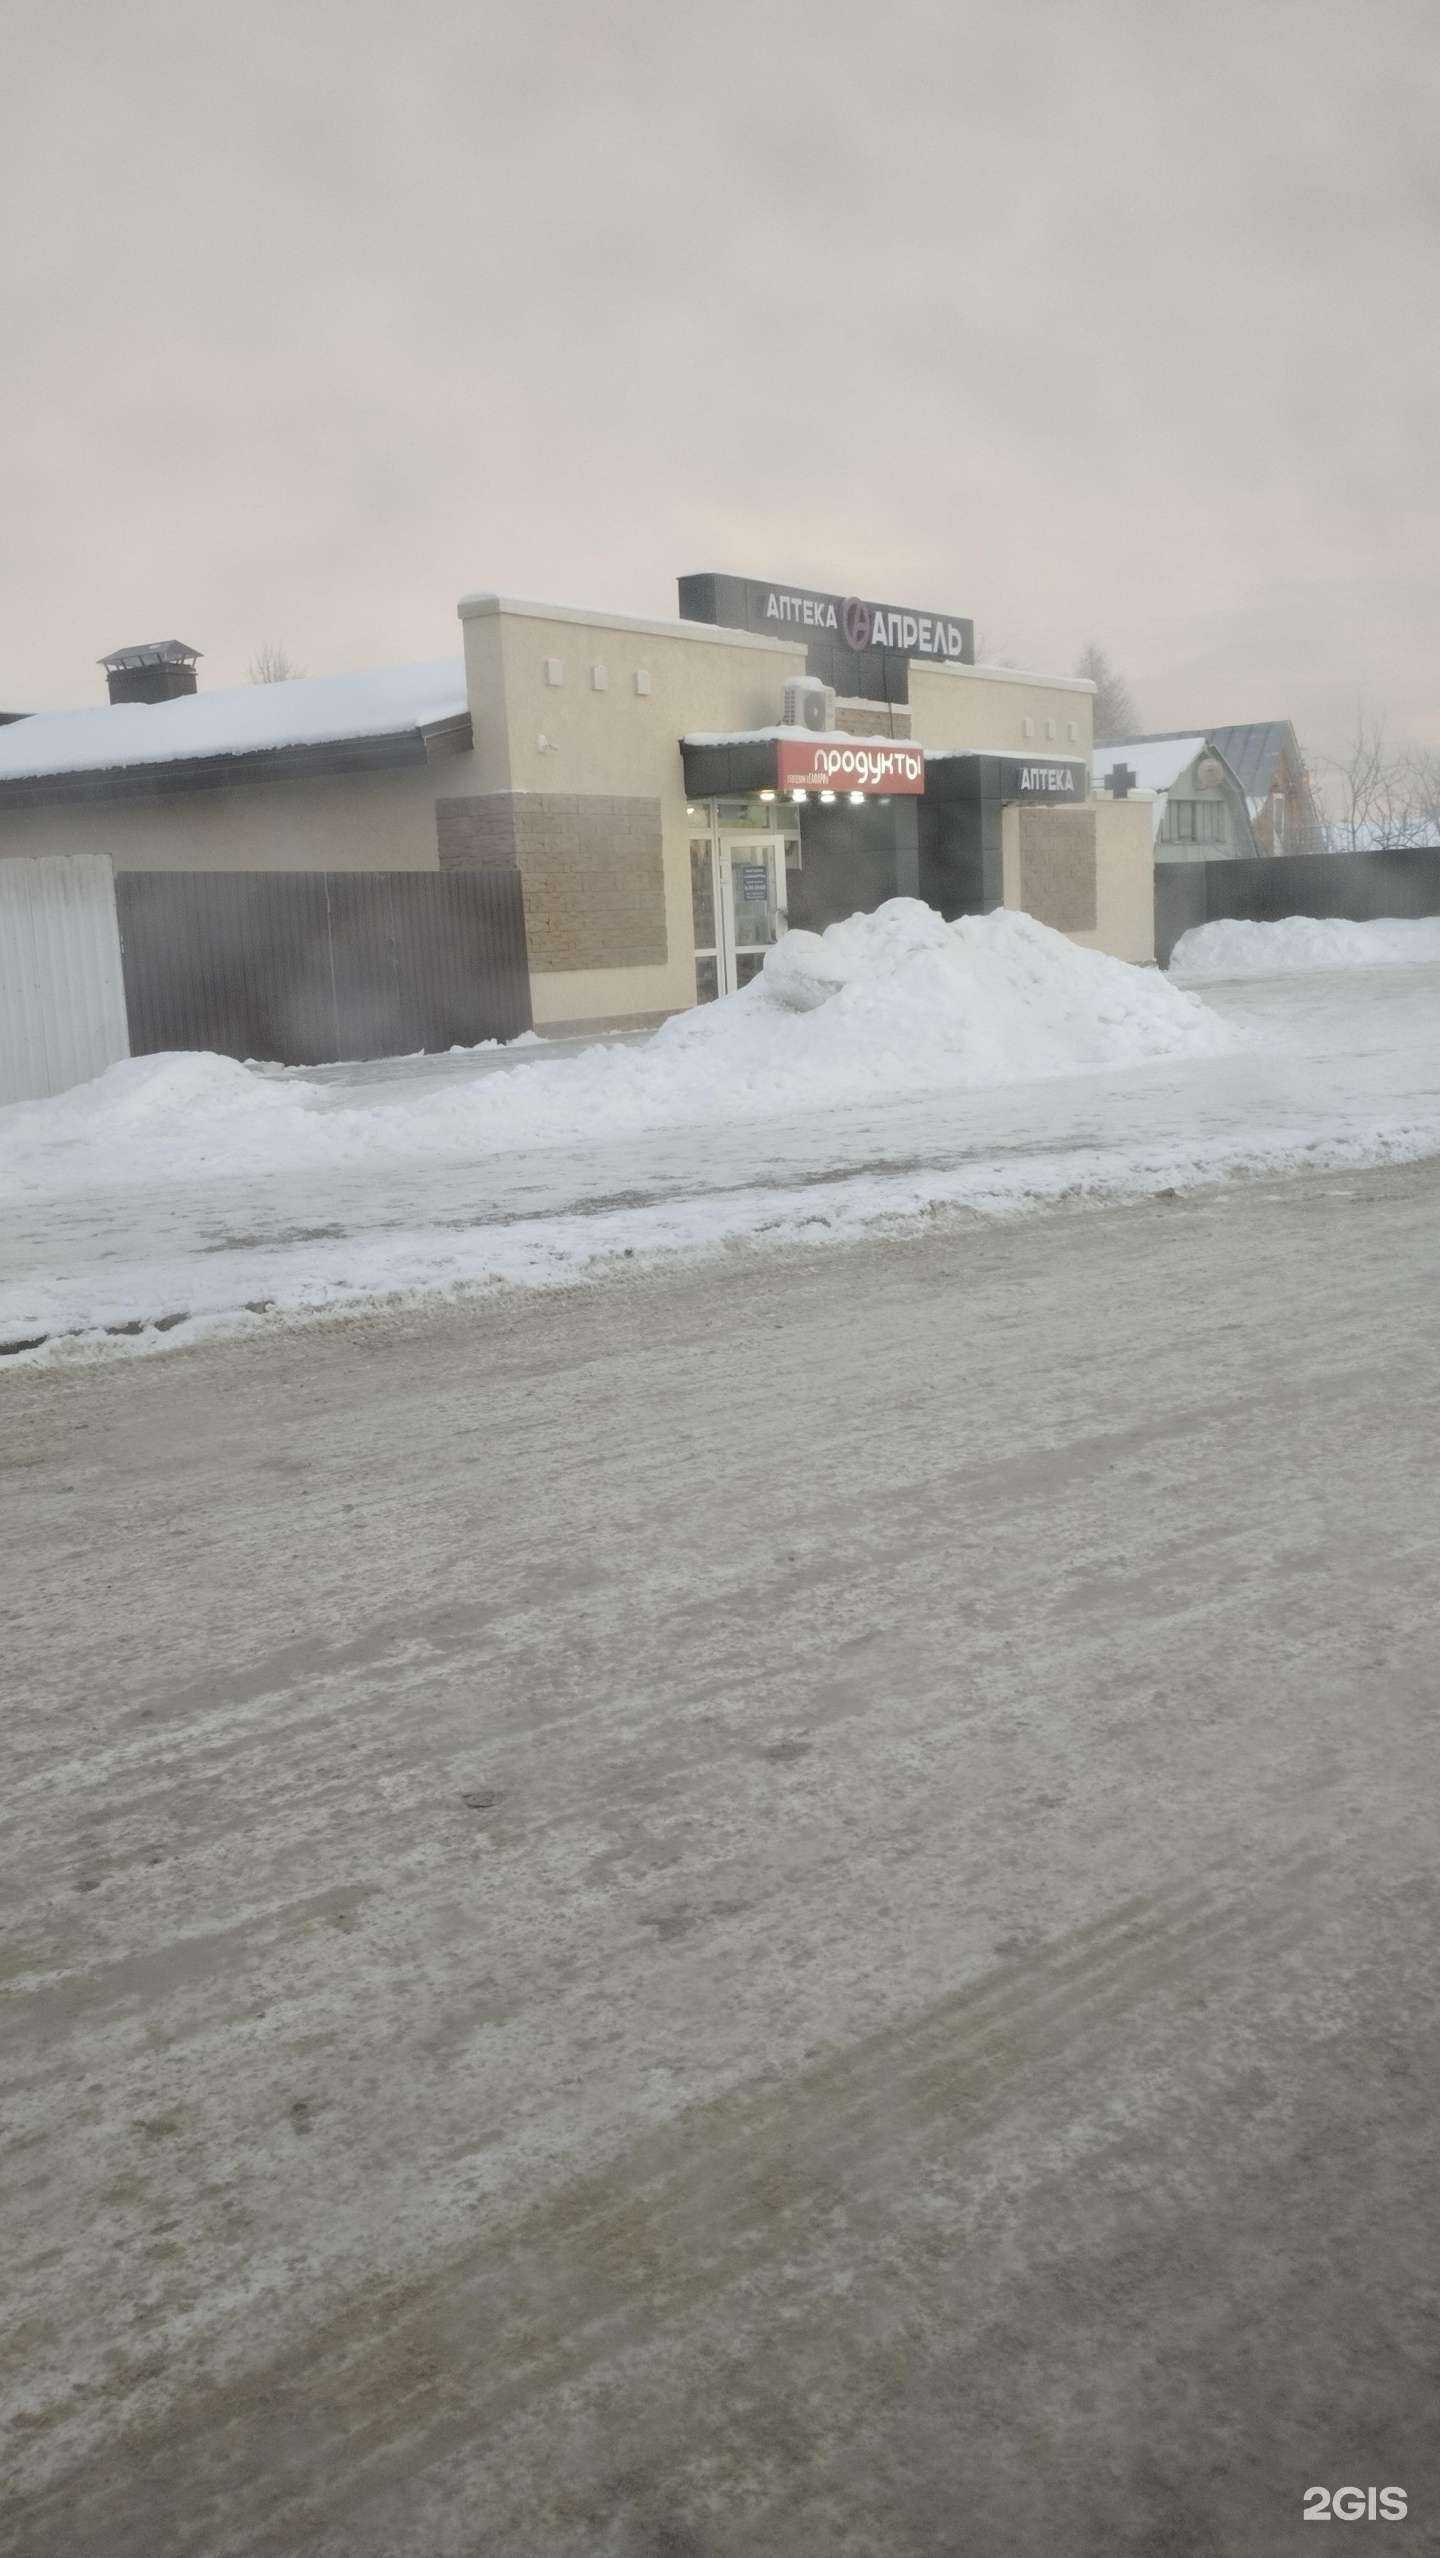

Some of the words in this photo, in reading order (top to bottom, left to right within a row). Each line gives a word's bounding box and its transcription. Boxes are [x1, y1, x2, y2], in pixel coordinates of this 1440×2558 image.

[766, 593, 838, 629] АПТЕКА
[871, 611, 962, 656] АПРЕЛЬ
[1021, 768, 1074, 791] АПТЕКА
